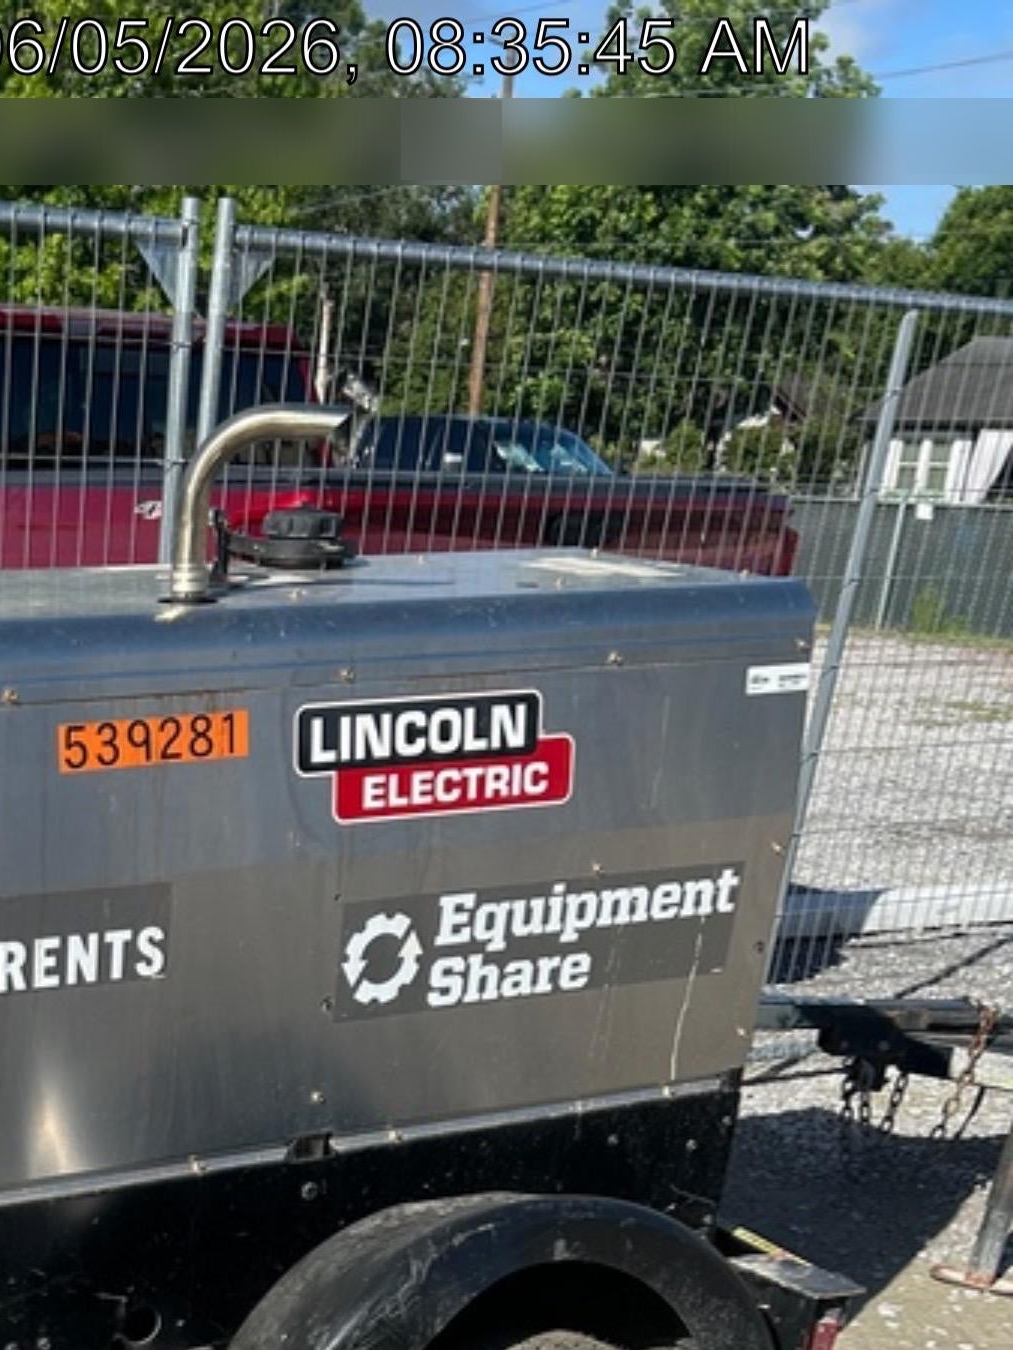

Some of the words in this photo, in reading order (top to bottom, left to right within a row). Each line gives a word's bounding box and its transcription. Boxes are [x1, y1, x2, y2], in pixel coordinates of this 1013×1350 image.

[63, 712, 237, 770] 539281
[310, 703, 527, 764] LINCOLN
[361, 761, 550, 811] ELECTRIC
[433, 868, 741, 952] Equipment
[427, 952, 591, 1008] Share
